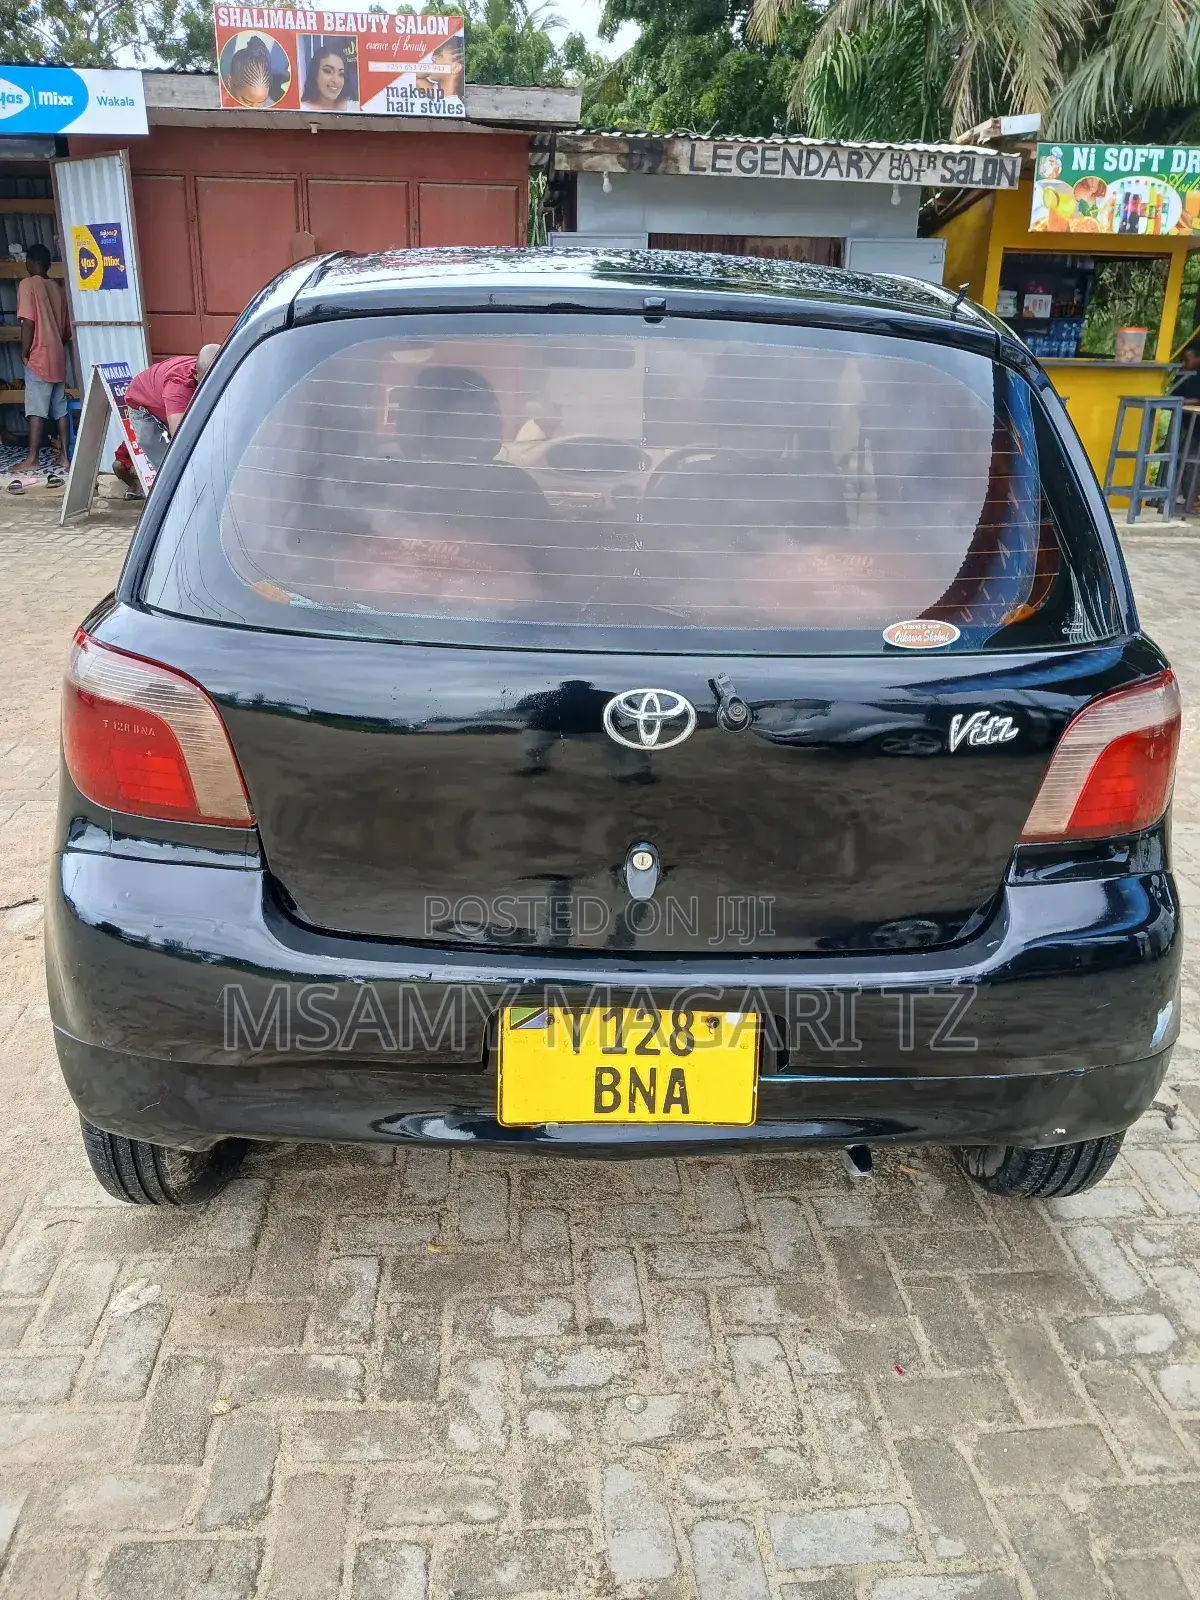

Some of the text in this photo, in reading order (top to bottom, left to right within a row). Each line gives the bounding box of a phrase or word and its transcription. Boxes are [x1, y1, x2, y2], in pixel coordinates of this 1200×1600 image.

[218, 7, 450, 36] SHALIMAAR BEAUTY SALON
[366, 35, 428, 58] essence of beauty
[96, 96, 135, 107] Wakala
[386, 84, 445, 103] makeup
[386, 98, 464, 115] hair styles
[688, 143, 886, 180] LEGENDARY
[888, 166, 926, 183] CUT
[1103, 147, 1165, 173] SOFT
[102, 719, 109, 728] T
[593, 1066, 690, 1115] BNA
